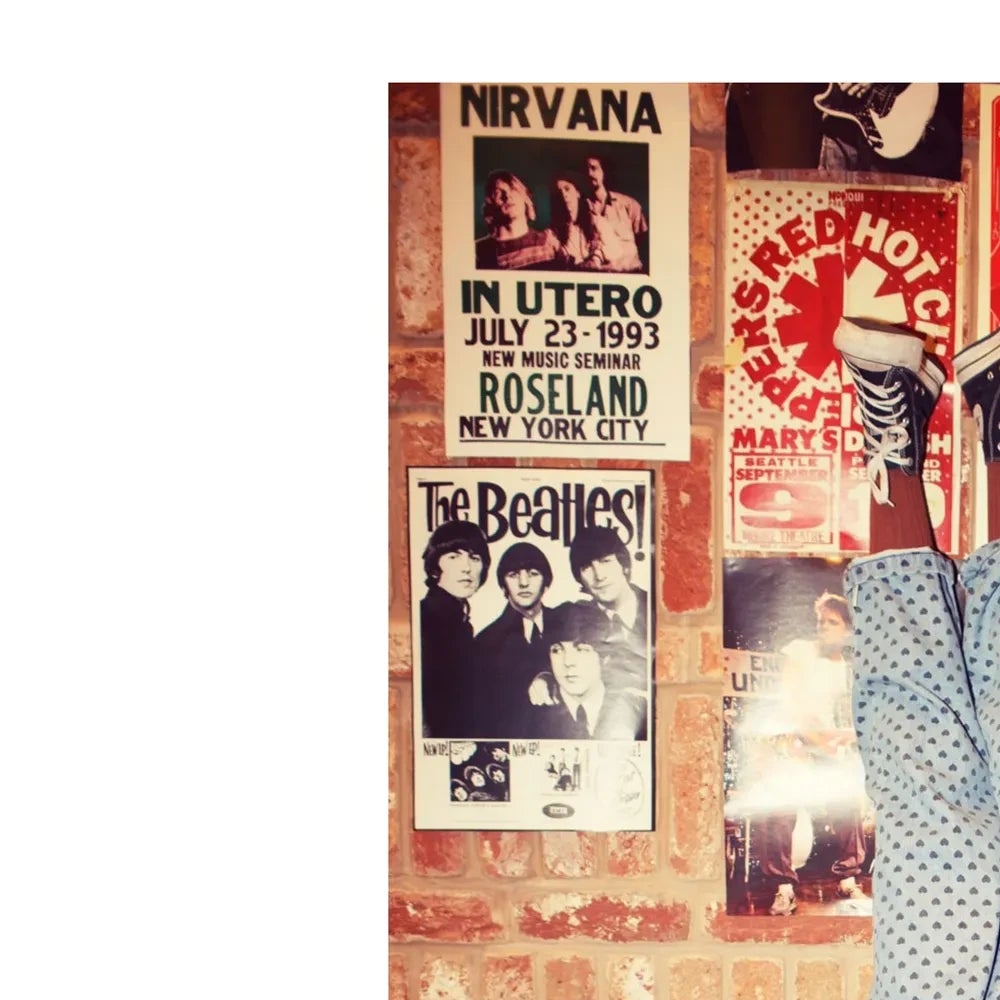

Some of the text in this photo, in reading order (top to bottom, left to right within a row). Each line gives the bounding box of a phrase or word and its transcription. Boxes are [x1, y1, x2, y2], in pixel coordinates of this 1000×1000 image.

[460, 85, 662, 134] NIRVANA
[750, 208, 845, 282] RED
[851, 211, 940, 283] HOT
[461, 280, 662, 319] IN UTERO
[465, 318, 529, 346] JULY
[732, 281, 858, 428] EPPERS
[482, 350, 641, 370] NEW MUSIC SEMINAR
[479, 372, 648, 417] ROSELAND
[459, 416, 649, 441] NEW YORK CITY
[733, 427, 838, 450] MARY'S
[744, 457, 818, 467] SEATTLE
[418, 481, 646, 562] The Beatles!
[739, 483, 829, 529] 9
